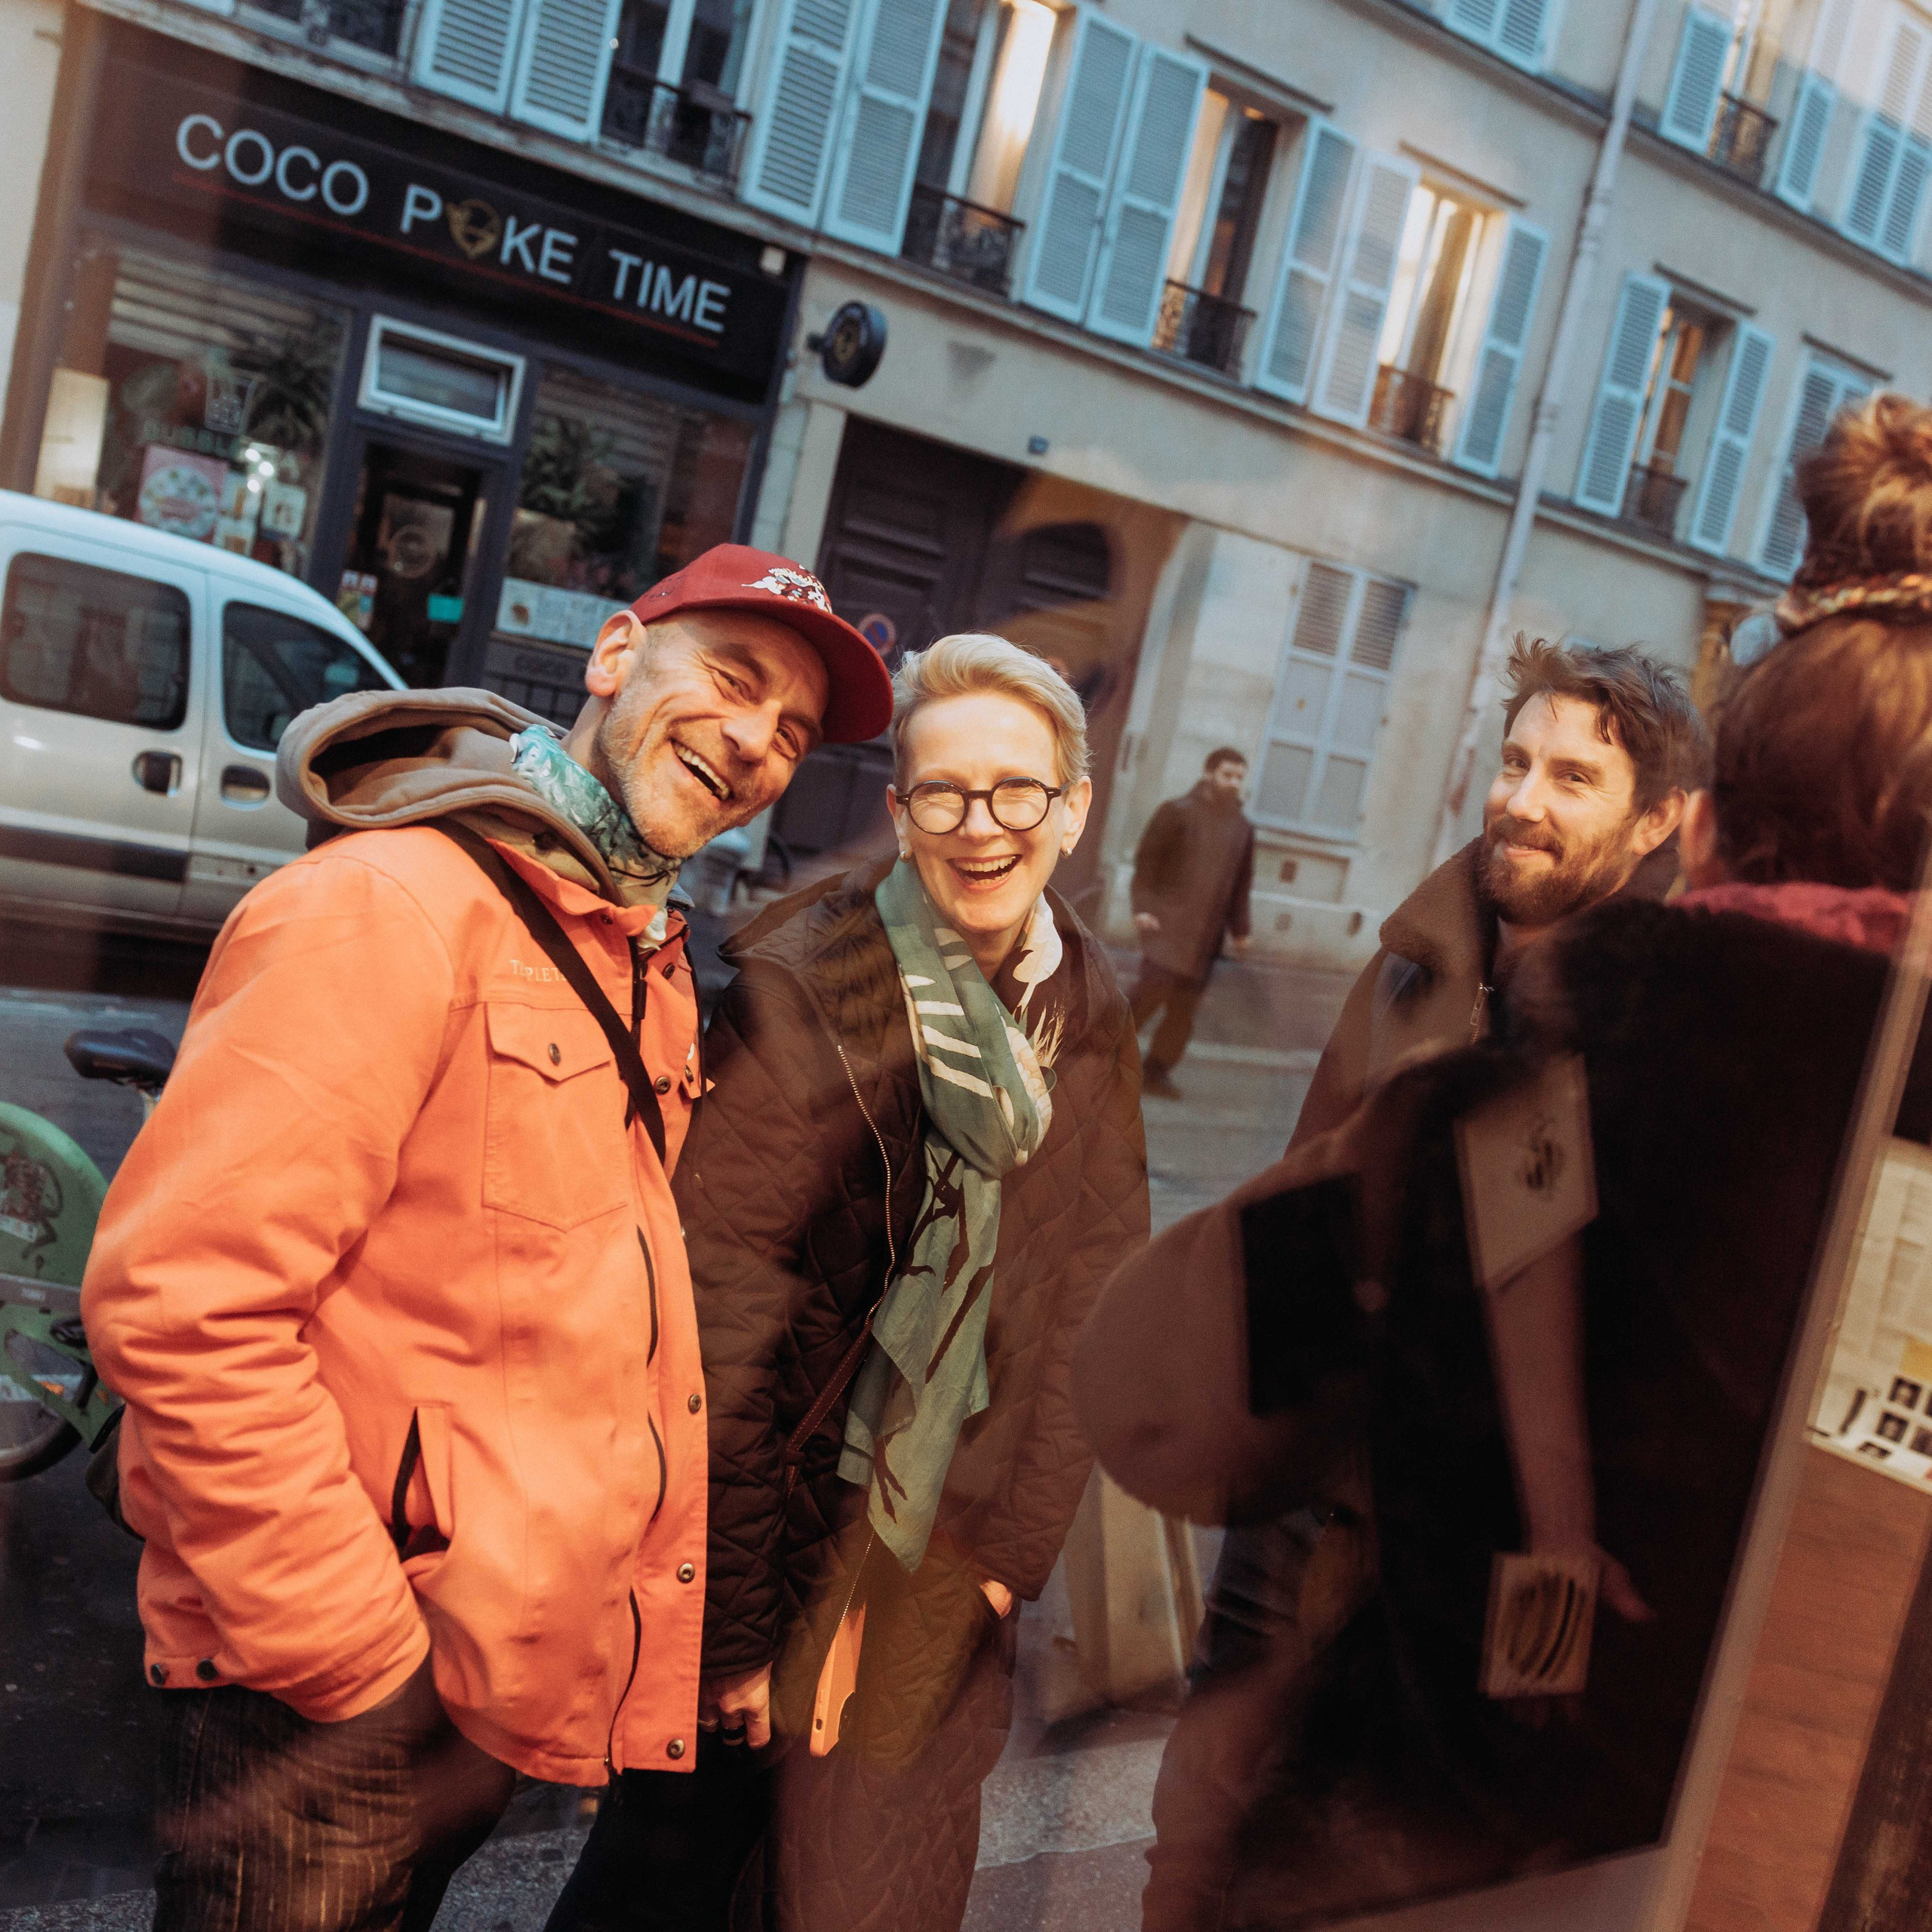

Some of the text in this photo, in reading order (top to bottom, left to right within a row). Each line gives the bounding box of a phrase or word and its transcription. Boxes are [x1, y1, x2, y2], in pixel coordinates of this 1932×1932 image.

[175, 113, 732, 334] COCO POKE TIME
